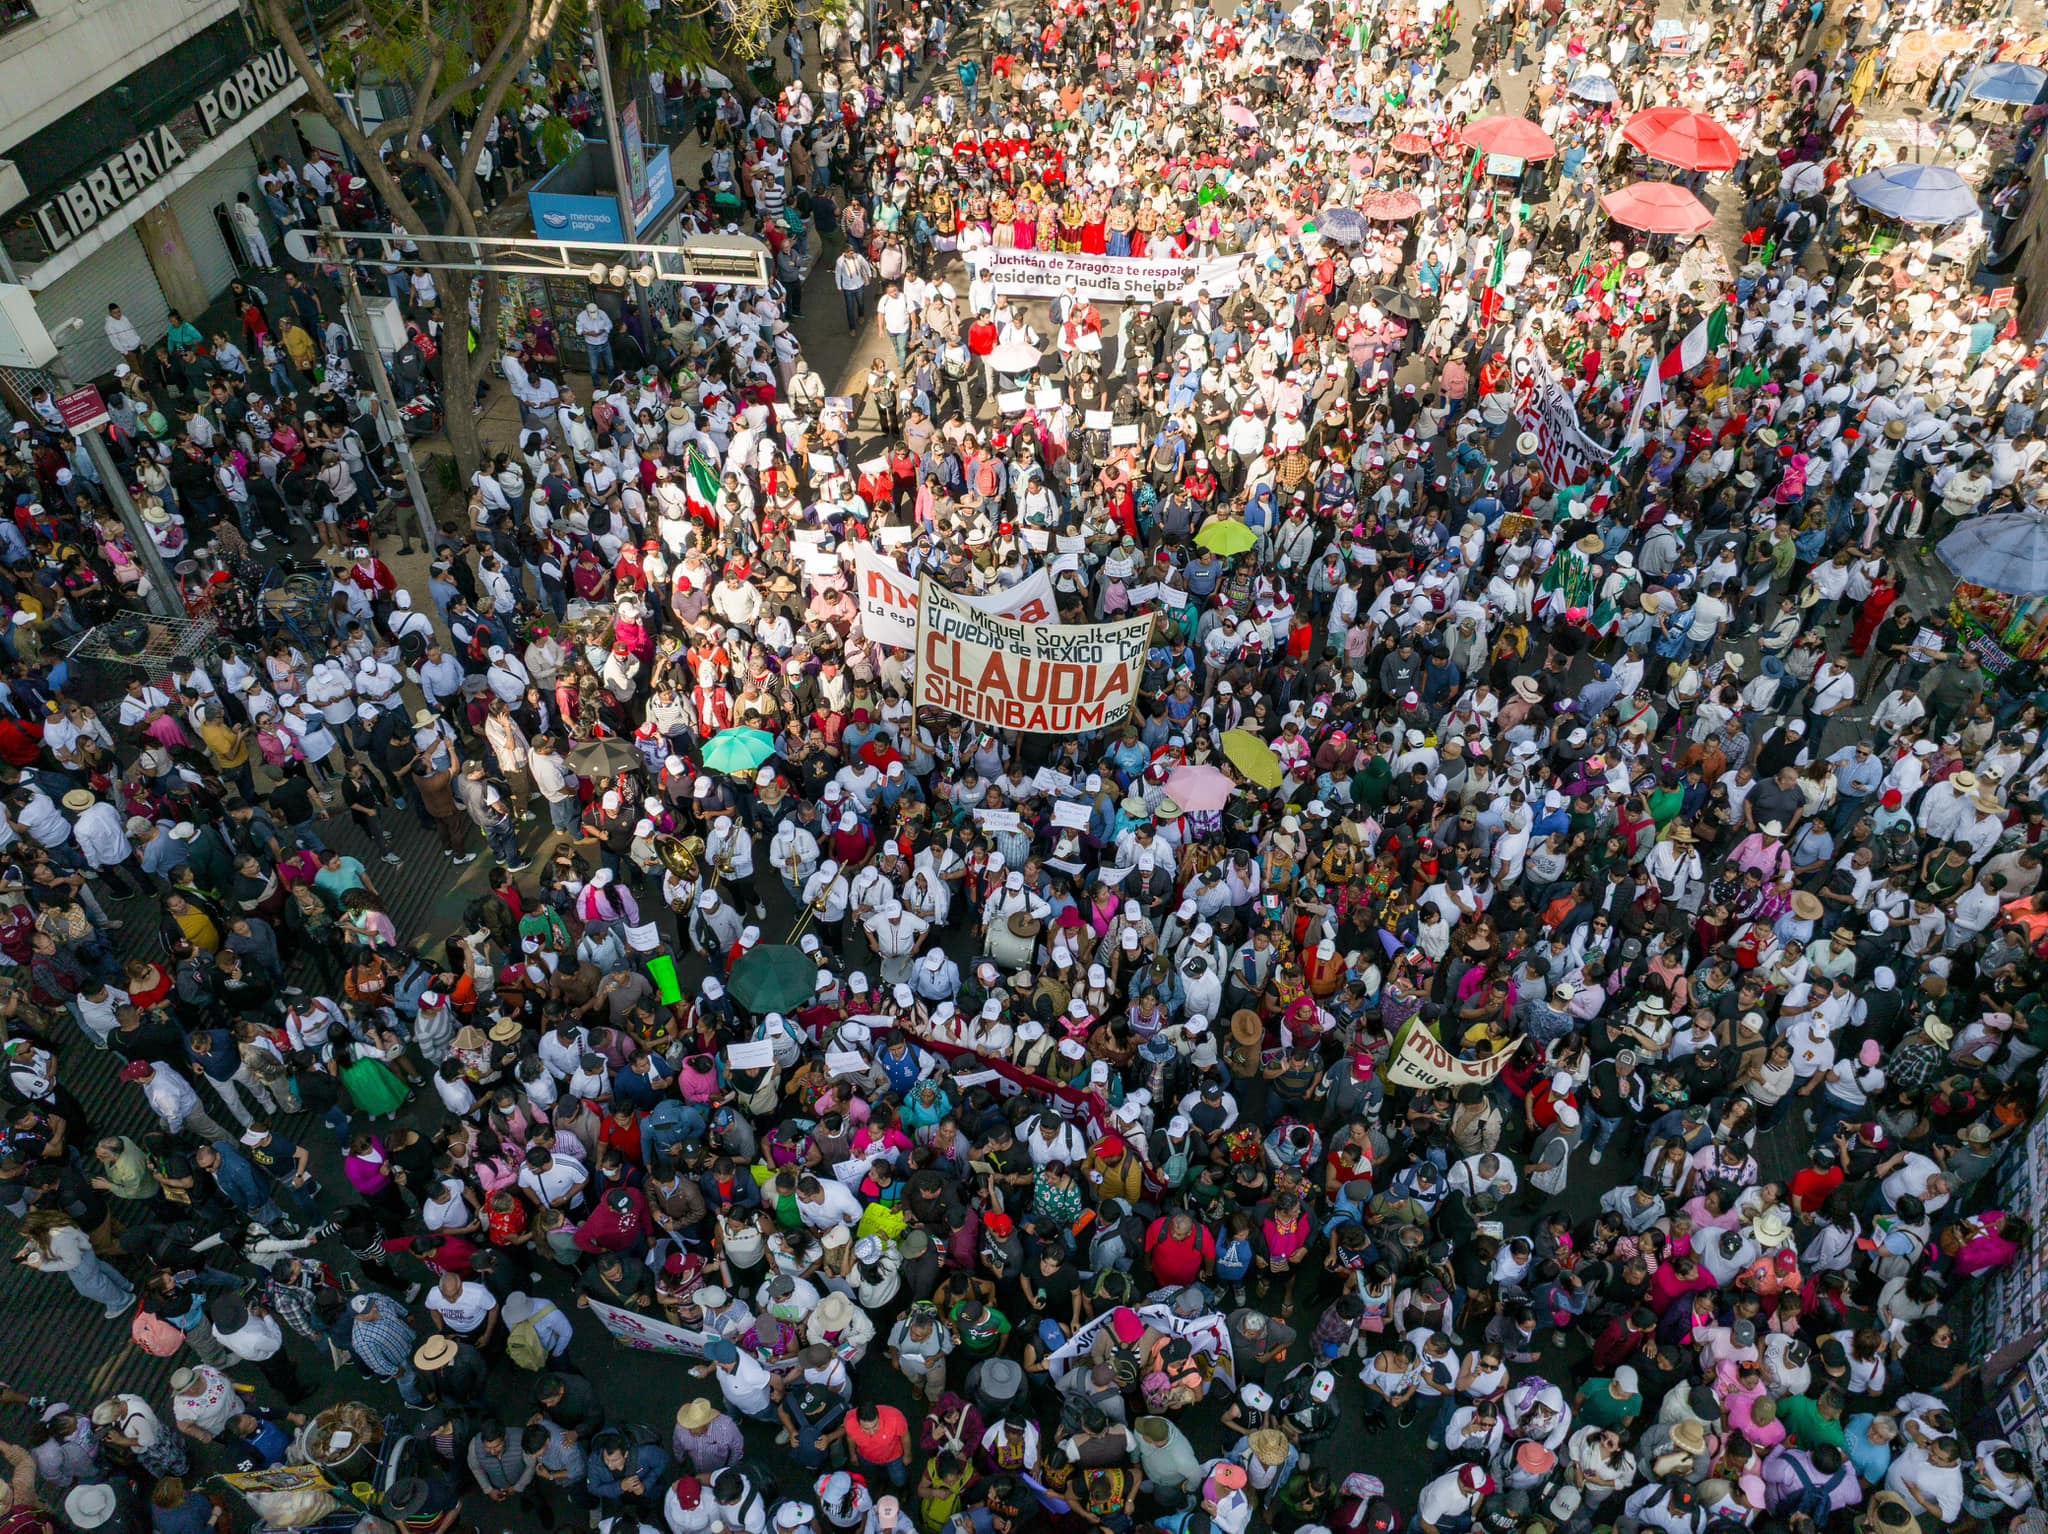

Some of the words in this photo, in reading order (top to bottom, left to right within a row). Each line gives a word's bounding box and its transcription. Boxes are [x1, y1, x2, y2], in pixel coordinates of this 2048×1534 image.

[36, 124, 186, 252] LIBRERIA
[570, 213, 611, 224] mercado
[572, 222, 596, 232] pago
[989, 254, 1045, 268] ¡Juchitán
[1049, 258, 1063, 269] de
[1066, 259, 1123, 275] Zaragoza
[1126, 265, 1139, 275] te
[991, 269, 1062, 285] residenta
[1123, 280, 1208, 292] Sheinba
[868, 602, 885, 617] La
[890, 612, 916, 628] esp
[928, 582, 960, 613] San
[970, 606, 1025, 641] Miguel
[928, 606, 941, 630] El
[943, 618, 1004, 650] pueblo
[1009, 641, 1031, 657] de
[1037, 645, 1103, 663] MEXICO
[926, 631, 1129, 706] CLAUDIA
[925, 674, 1105, 731] SHEINBAUM
